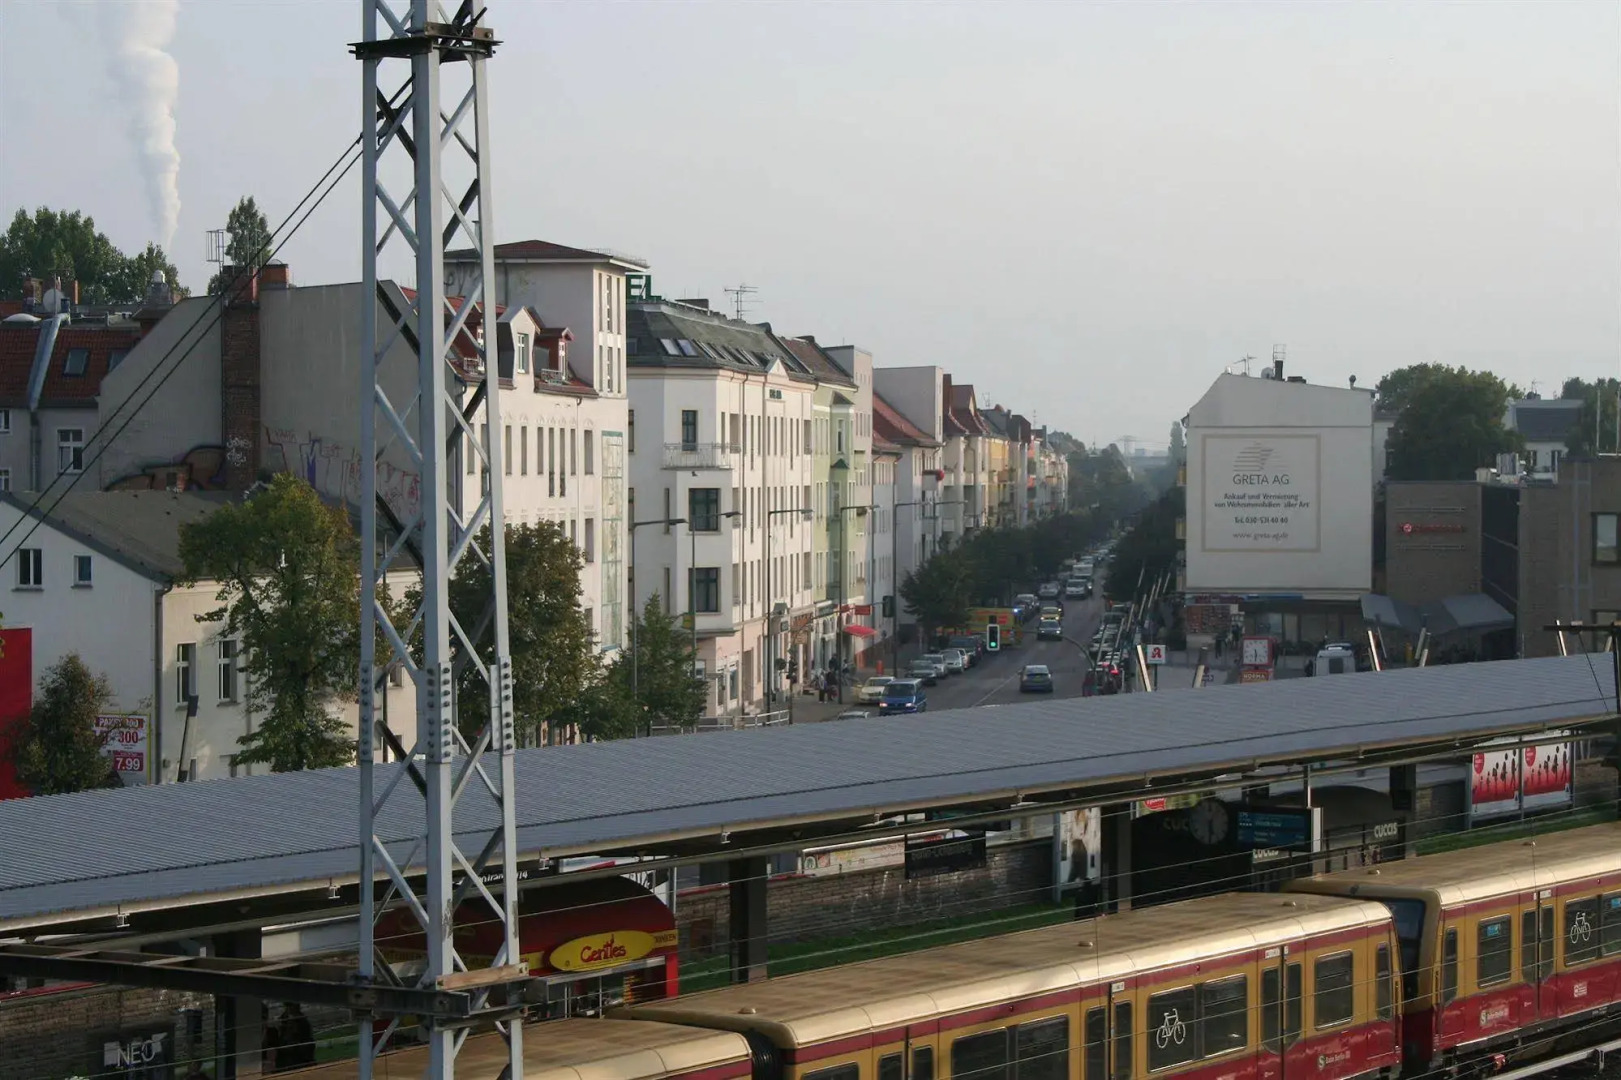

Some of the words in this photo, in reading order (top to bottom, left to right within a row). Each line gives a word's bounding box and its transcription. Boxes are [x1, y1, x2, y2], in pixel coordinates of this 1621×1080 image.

[1232, 474, 1269, 485] GRETA
[1272, 474, 1290, 485] AG
[116, 757, 141, 771] 7.99
